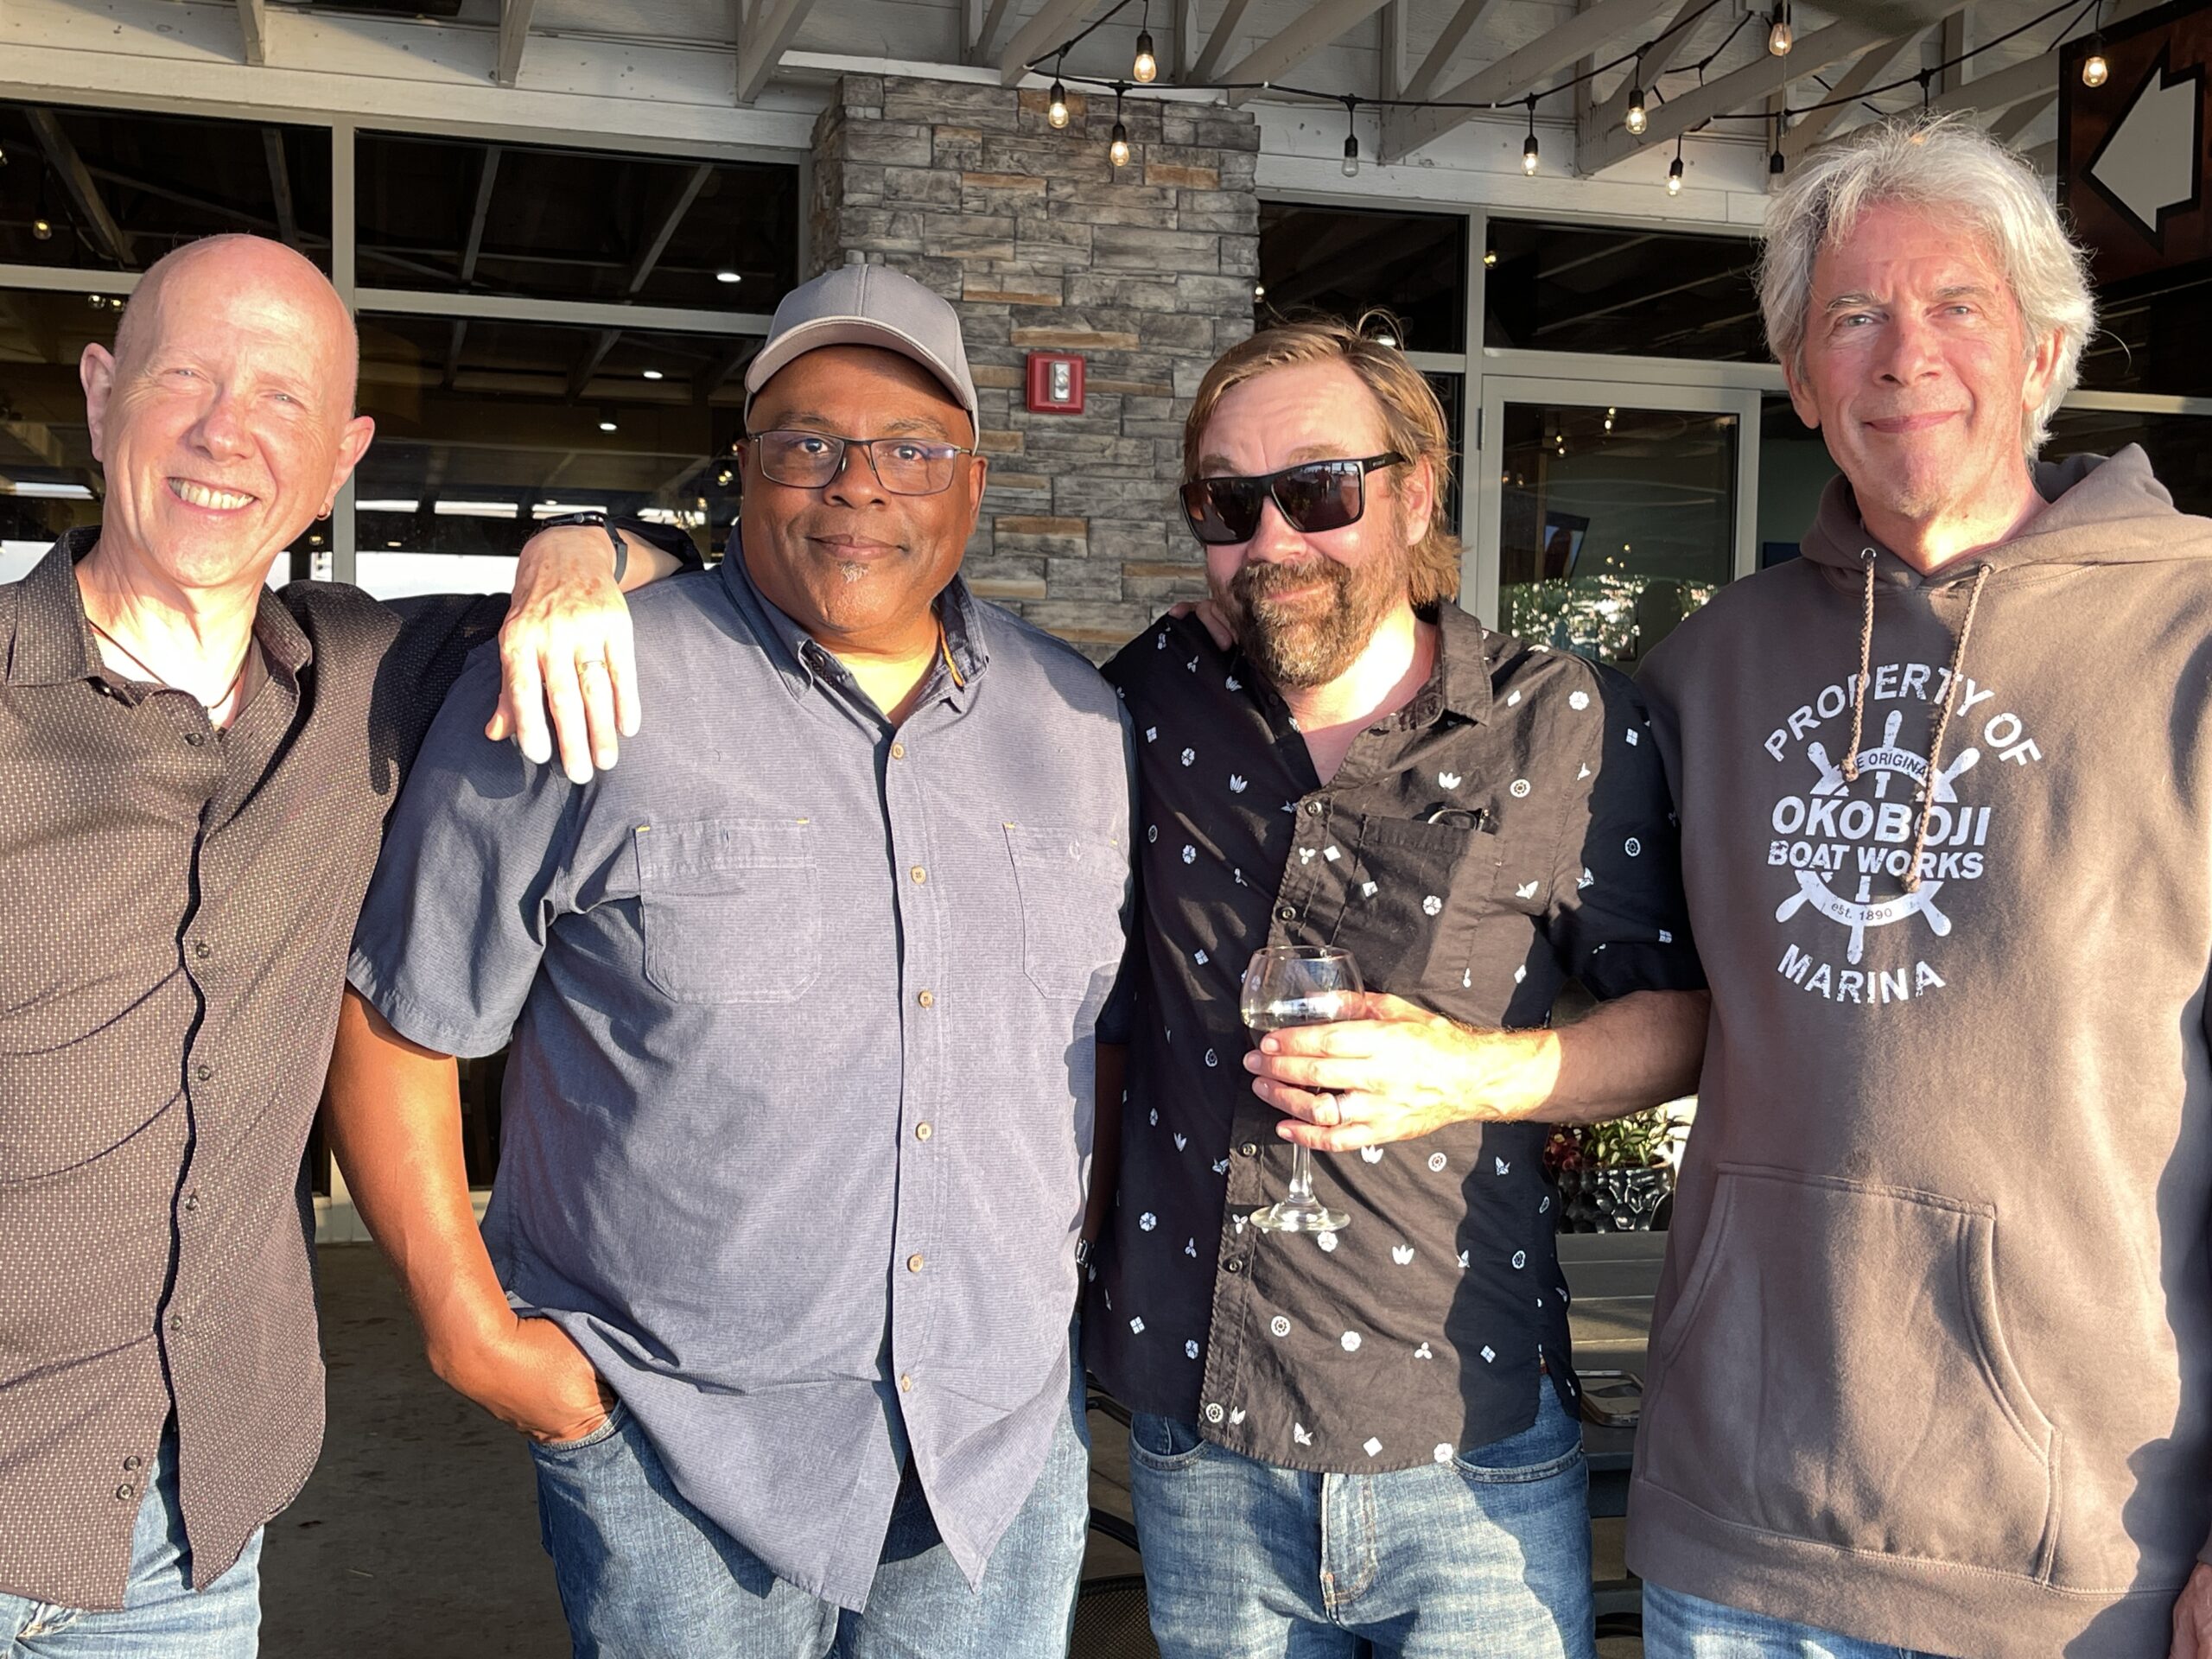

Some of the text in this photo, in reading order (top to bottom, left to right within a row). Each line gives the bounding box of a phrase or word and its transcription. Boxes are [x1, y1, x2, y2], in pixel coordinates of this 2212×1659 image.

[1764, 664, 2042, 766] PROPERTY OF
[1868, 753, 1932, 779] ORIGINA
[1771, 796, 1991, 846] OKOBOJI
[1768, 840, 1985, 880] BOAT WORKS
[1831, 902, 1893, 921] est. 1890
[1777, 943, 1947, 1004] MARINA
